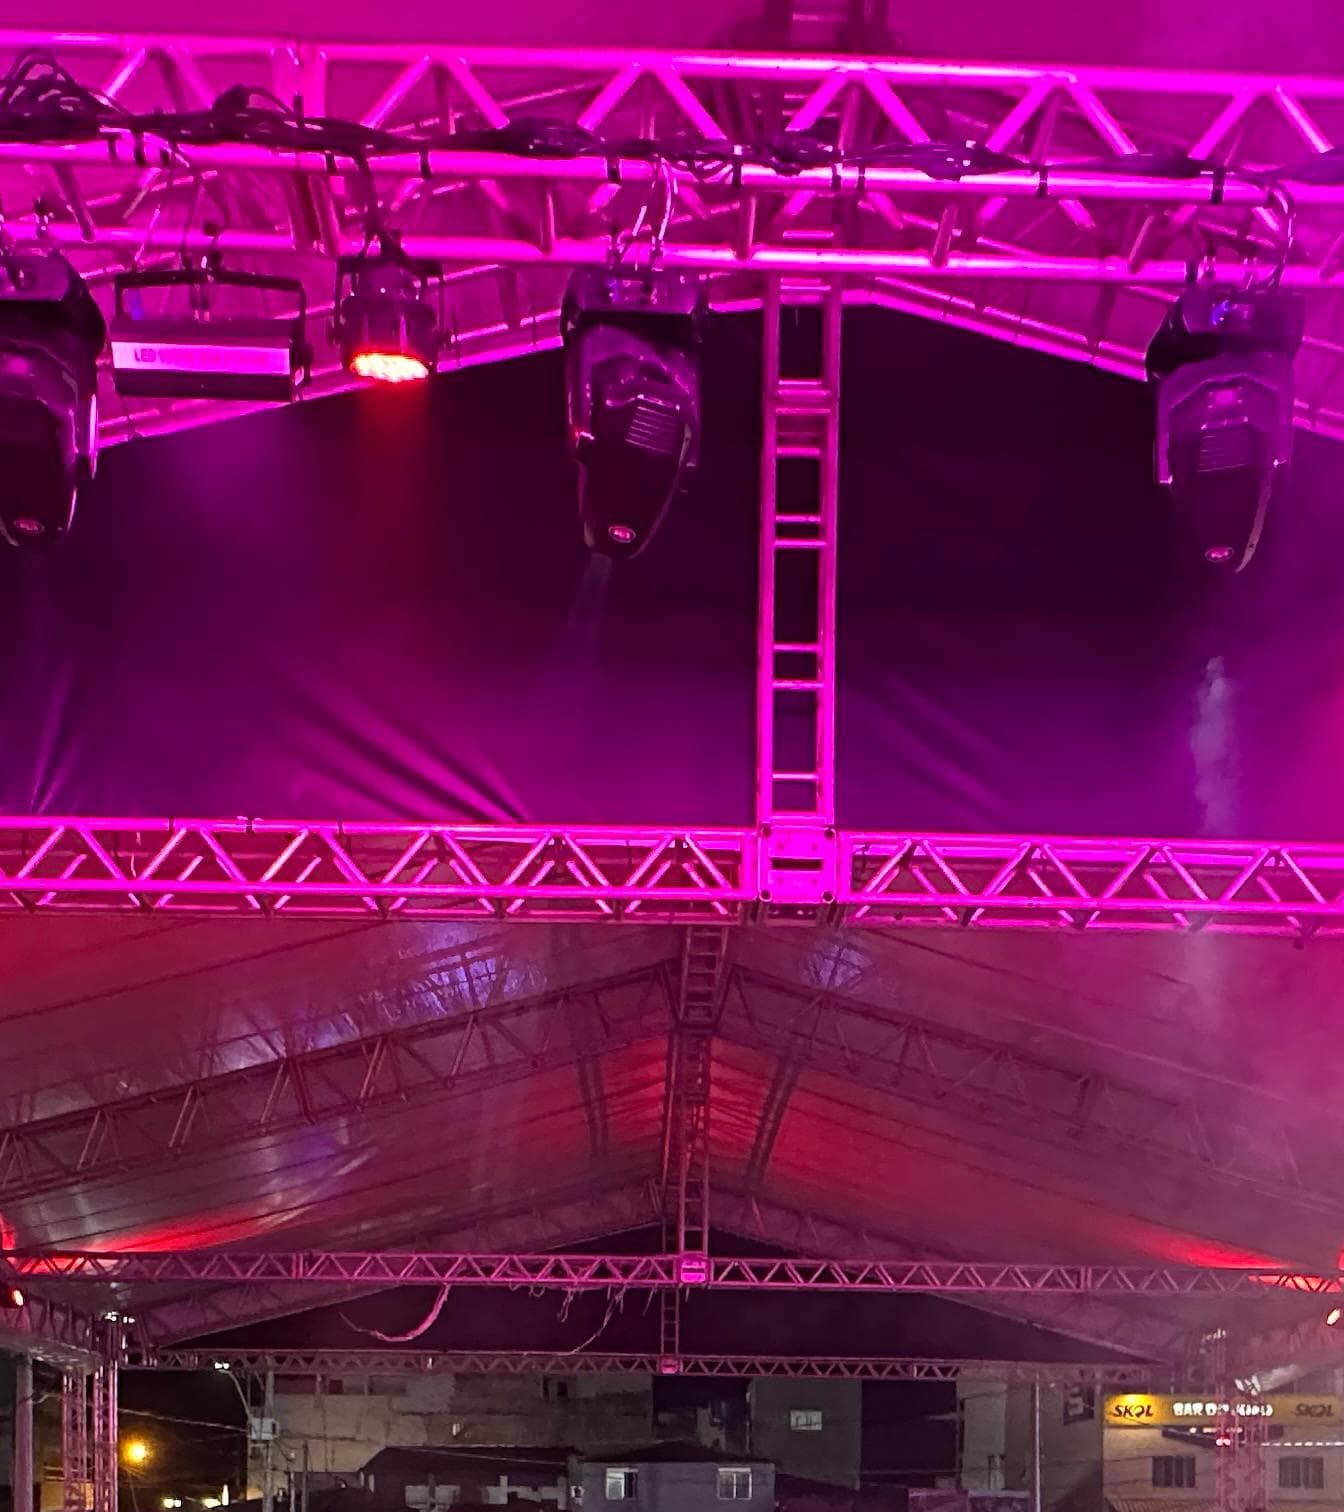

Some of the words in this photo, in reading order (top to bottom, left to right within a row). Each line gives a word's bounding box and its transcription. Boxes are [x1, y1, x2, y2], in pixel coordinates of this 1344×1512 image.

[1112, 1404, 1154, 1418] SKOL
[1173, 1402, 1203, 1416] BAR
[1295, 1402, 1334, 1418] SKOL
